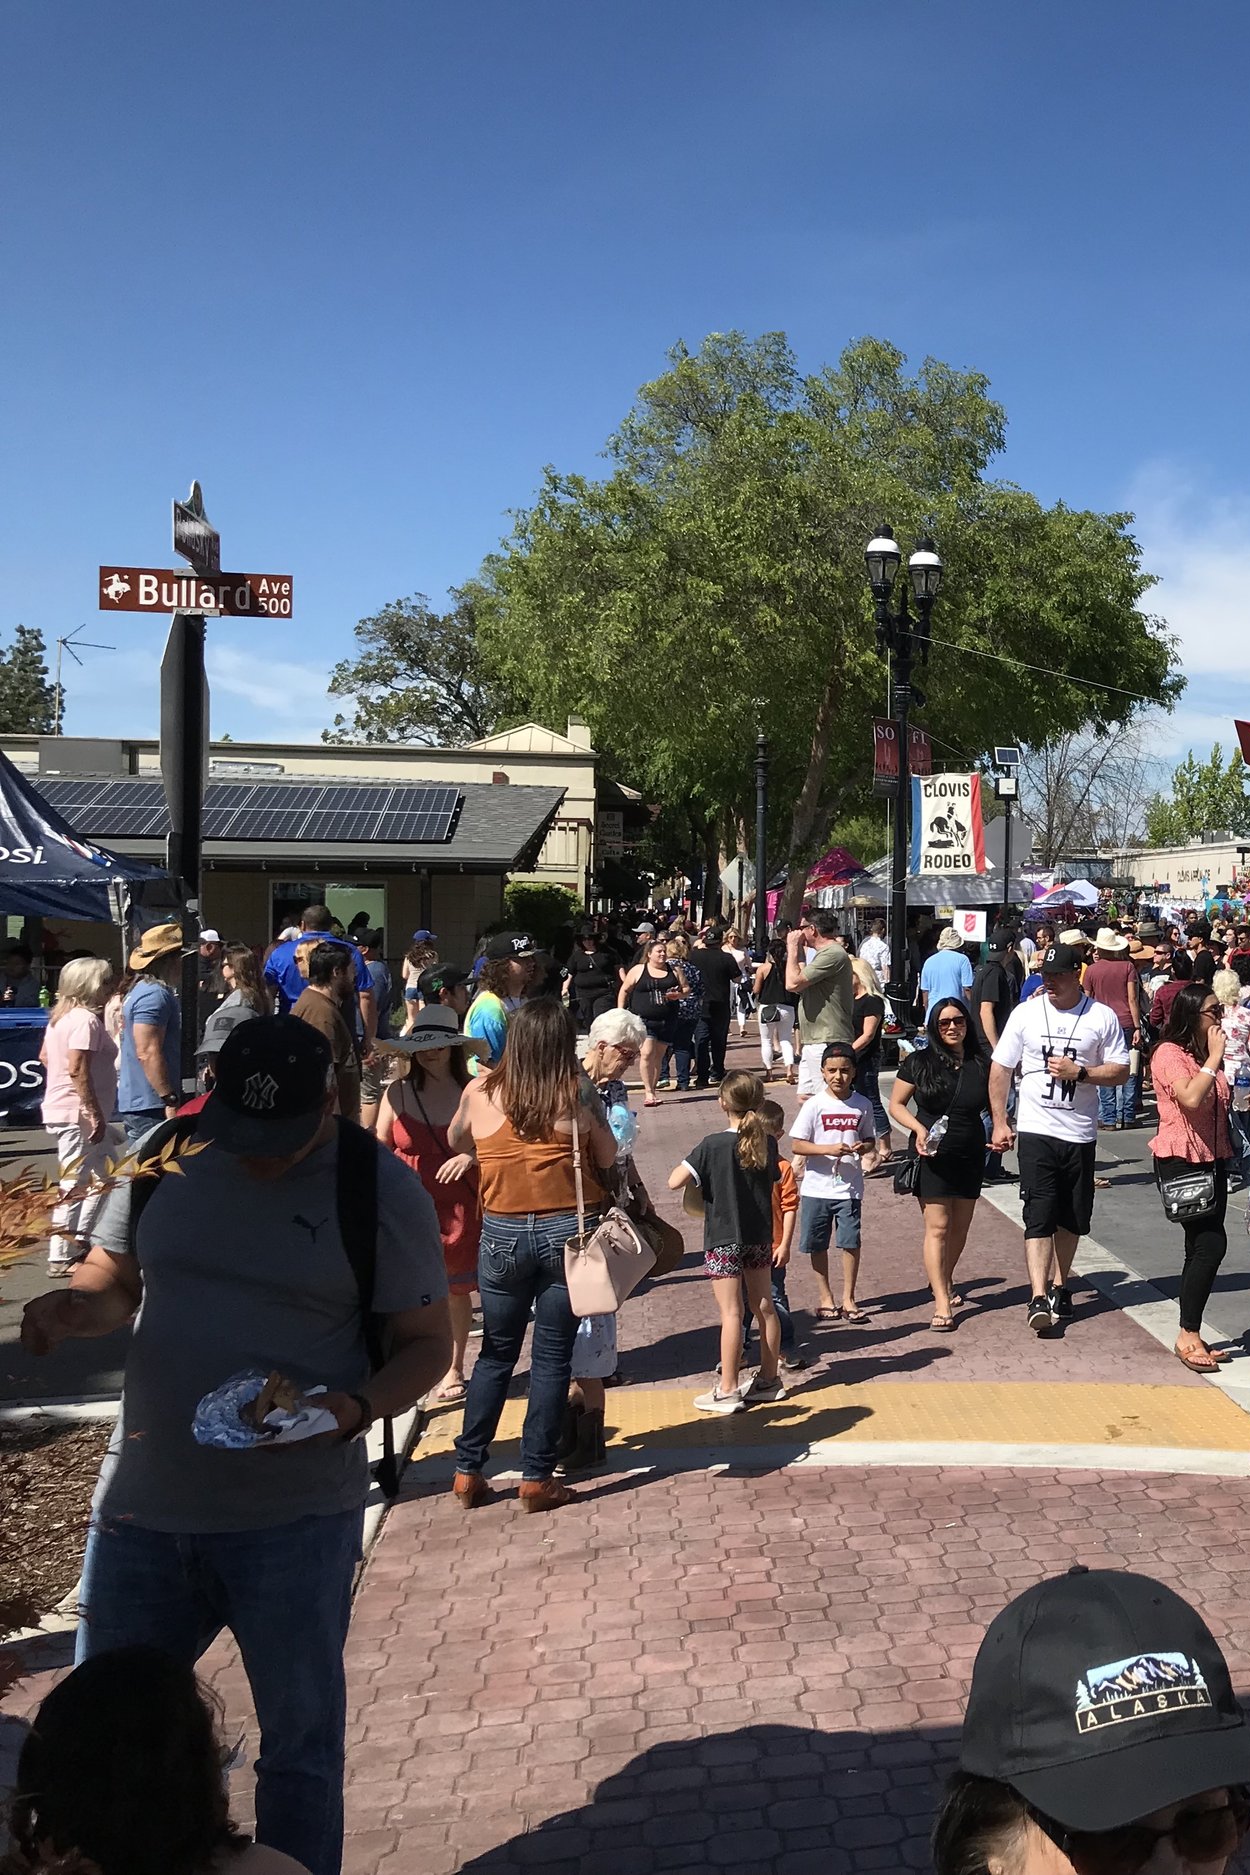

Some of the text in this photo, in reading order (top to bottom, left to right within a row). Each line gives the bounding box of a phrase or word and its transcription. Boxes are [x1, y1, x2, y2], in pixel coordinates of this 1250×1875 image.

[138, 574, 290, 610] Bullard Ave
[258, 597, 290, 615] 500
[876, 725, 895, 740] SO
[923, 783, 970, 798] CLOVIS
[923, 854, 971, 868] RODEO
[1046, 949, 1056, 962] B
[1086, 1691, 1206, 1728] ALASKA
